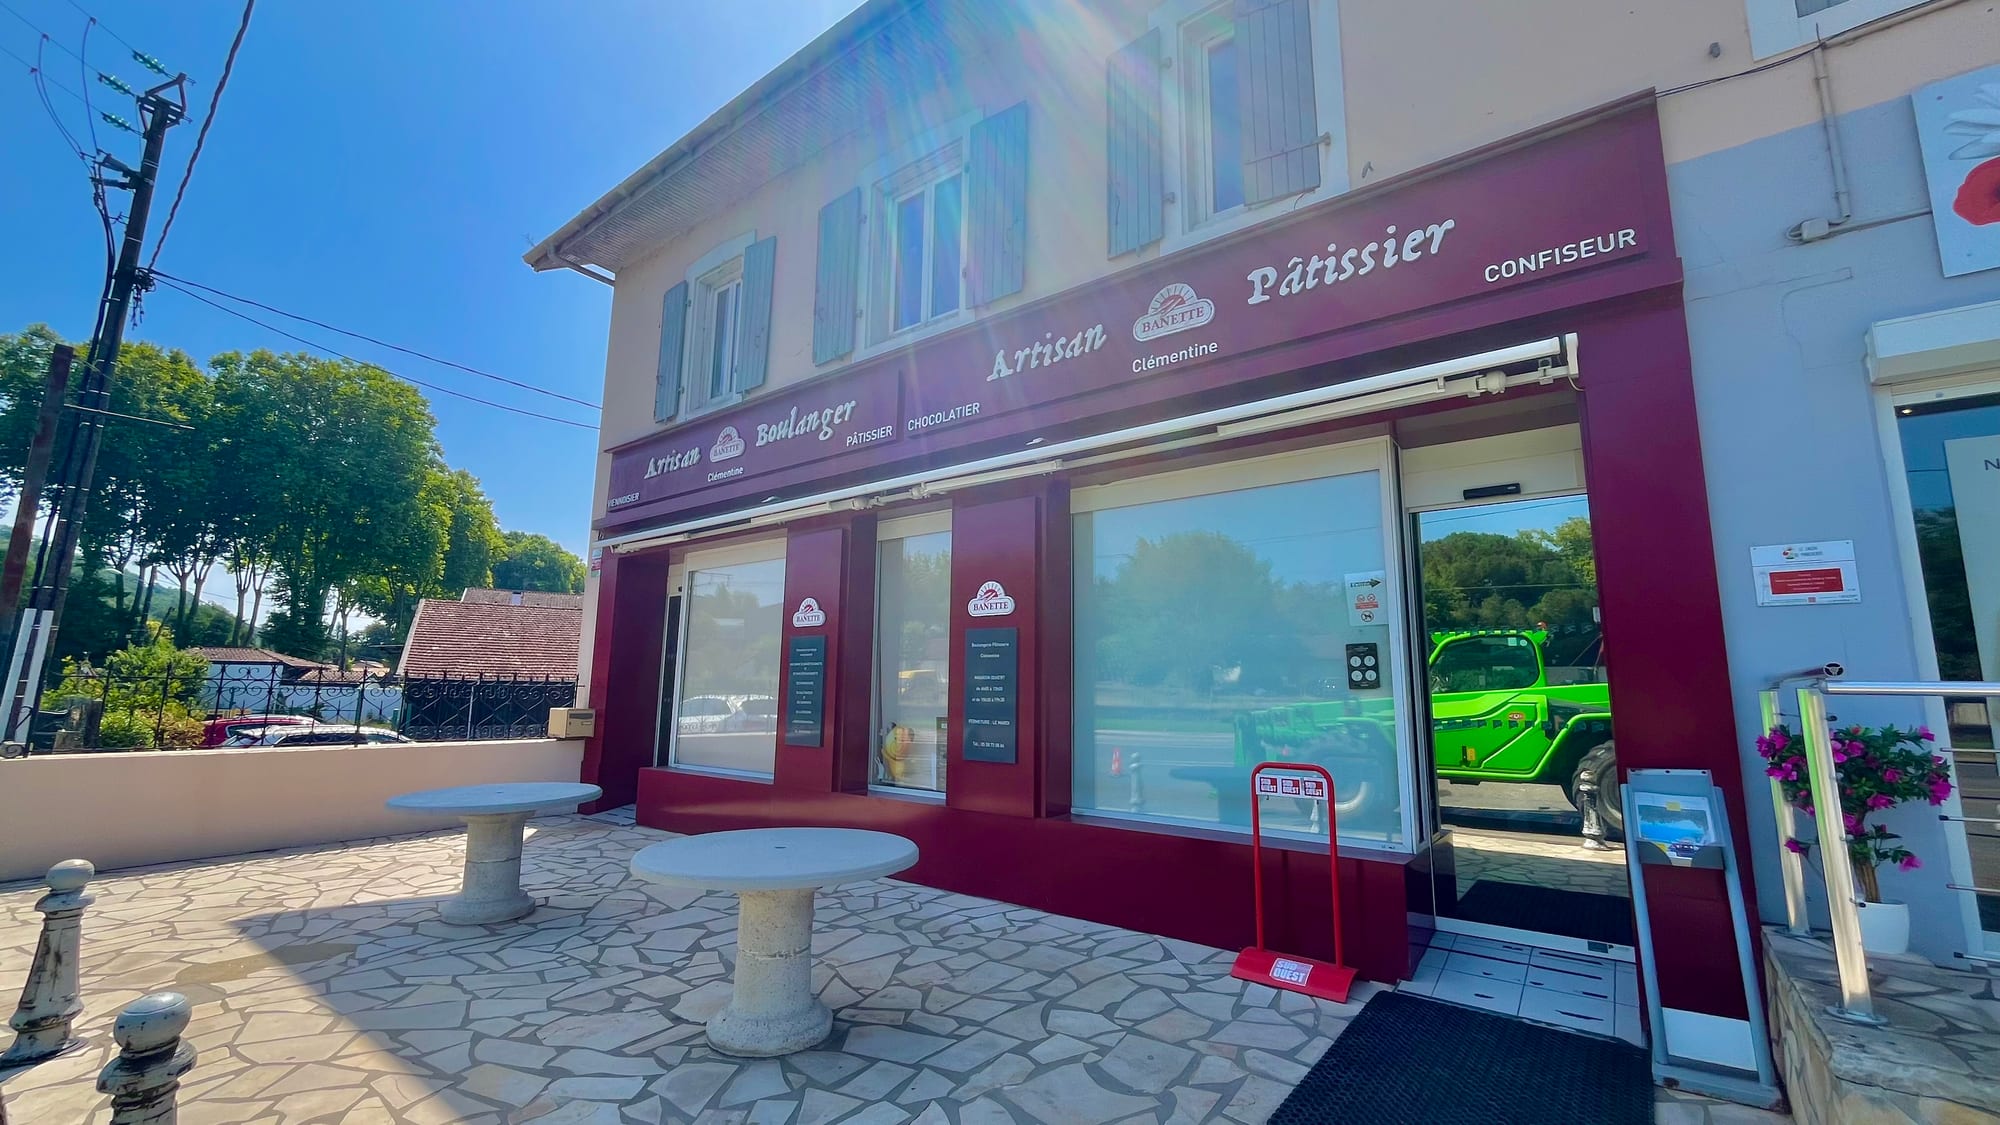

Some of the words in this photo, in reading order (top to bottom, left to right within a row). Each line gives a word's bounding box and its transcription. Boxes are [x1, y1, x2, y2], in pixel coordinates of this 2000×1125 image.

[1247, 220, 1455, 304] Pâtissier
[1484, 229, 1637, 283] CONFISEUR
[1142, 306, 1204, 333] BANETTE
[986, 322, 1107, 382] Artisan
[1132, 342, 1218, 373] Clémentine
[756, 400, 857, 447] Boulanger
[907, 402, 980, 431] CHOCOLATIER
[846, 425, 893, 447] PÂTISSIER
[644, 446, 701, 479] Artisan
[708, 467, 743, 482] Clémentine
[973, 601, 1009, 611] BANETTE
[1273, 968, 1306, 982] OUEST
[1276, 961, 1298, 970] SUD
